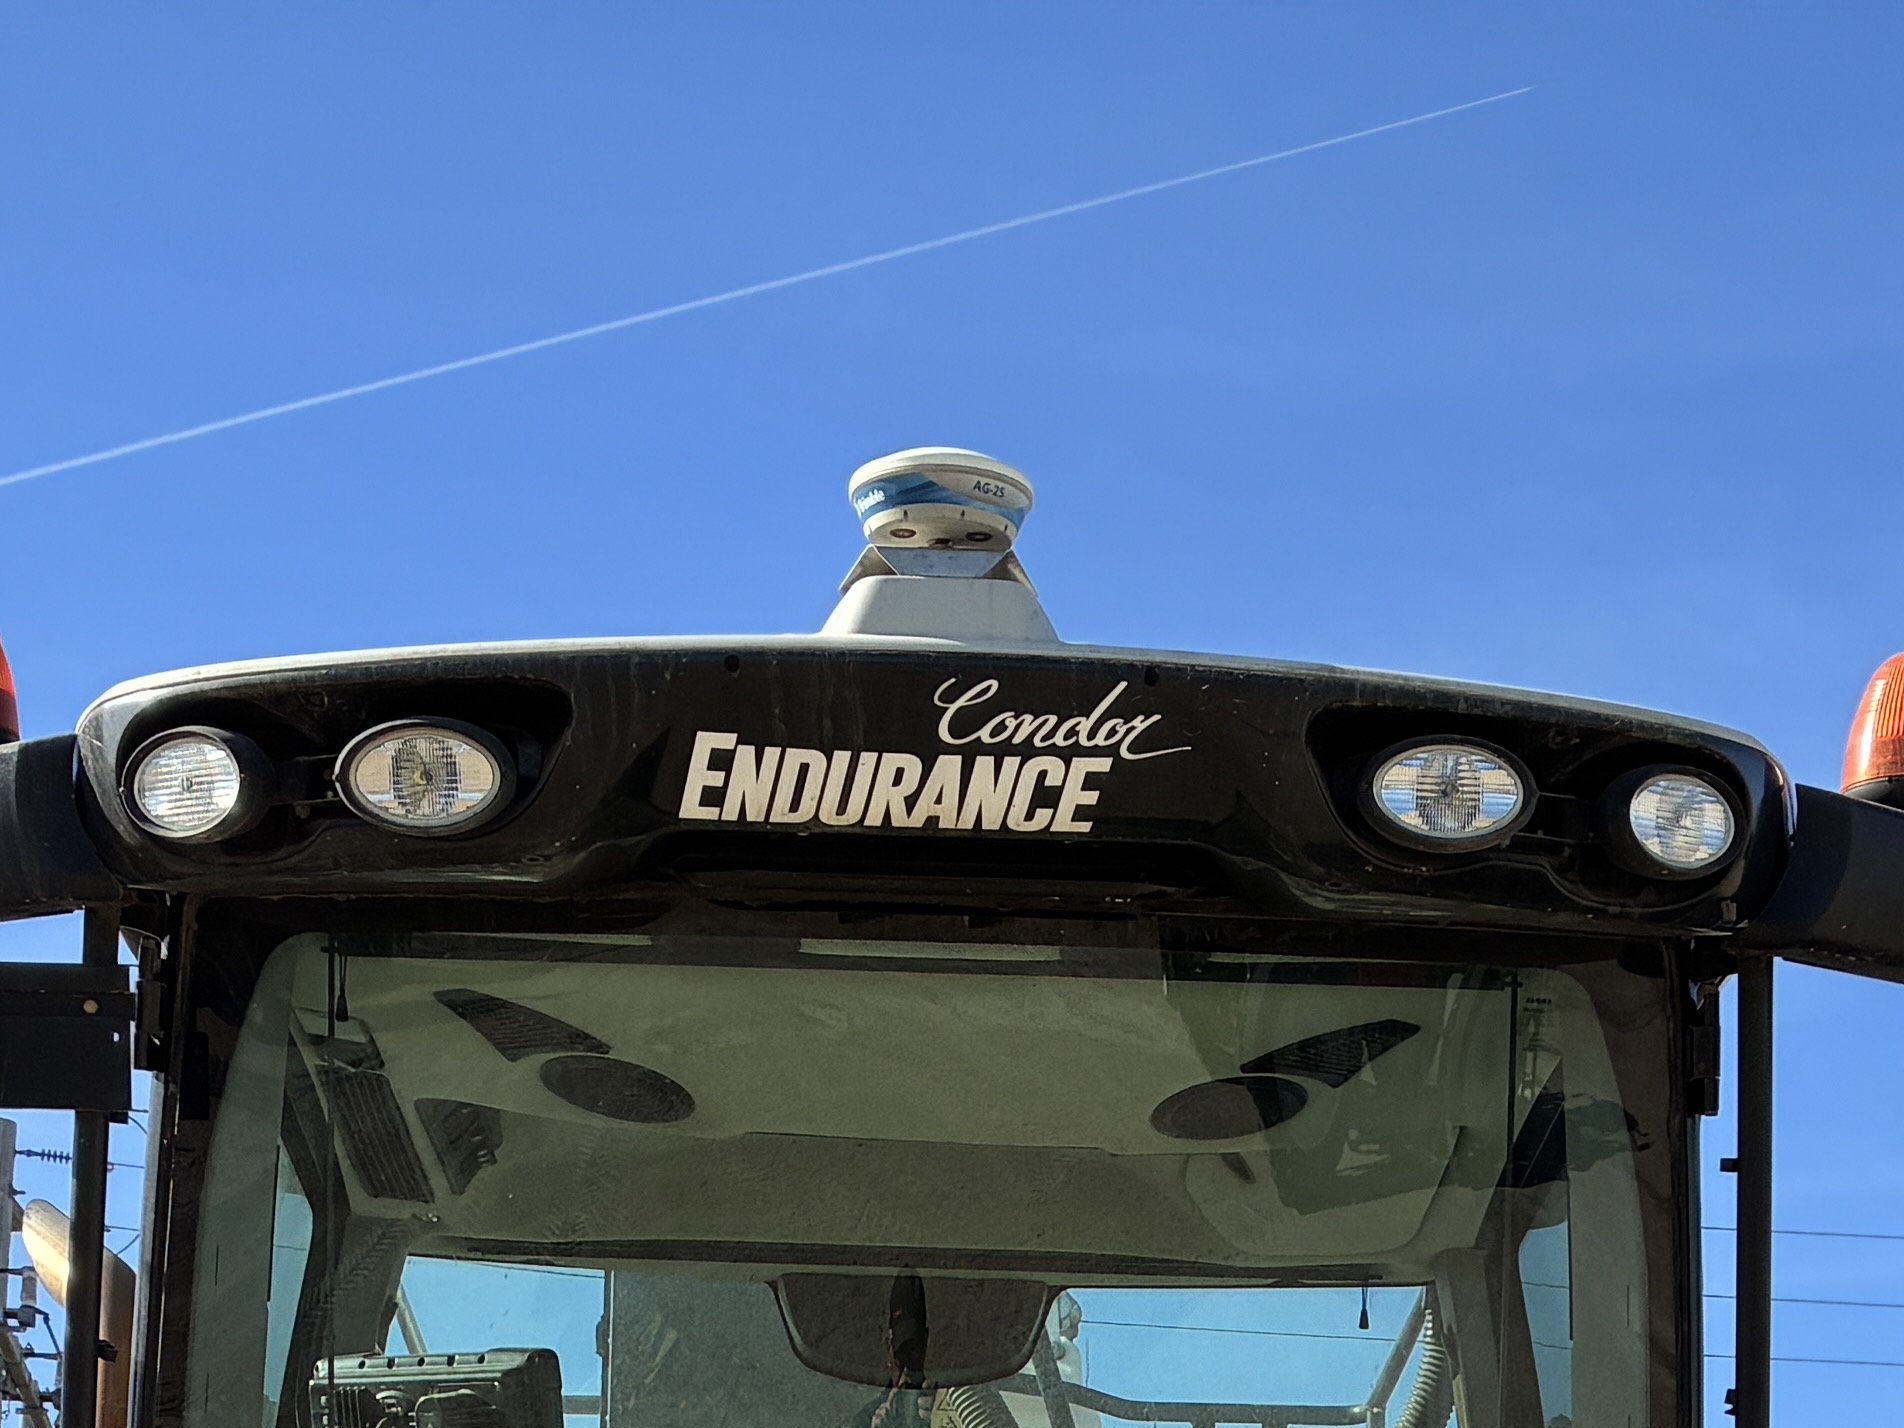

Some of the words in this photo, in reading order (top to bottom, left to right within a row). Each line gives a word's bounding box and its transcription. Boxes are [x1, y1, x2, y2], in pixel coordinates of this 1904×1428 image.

[972, 480, 1006, 498] AG-25
[933, 676, 1192, 760] Condor
[678, 729, 1114, 834] ENDURANCE
